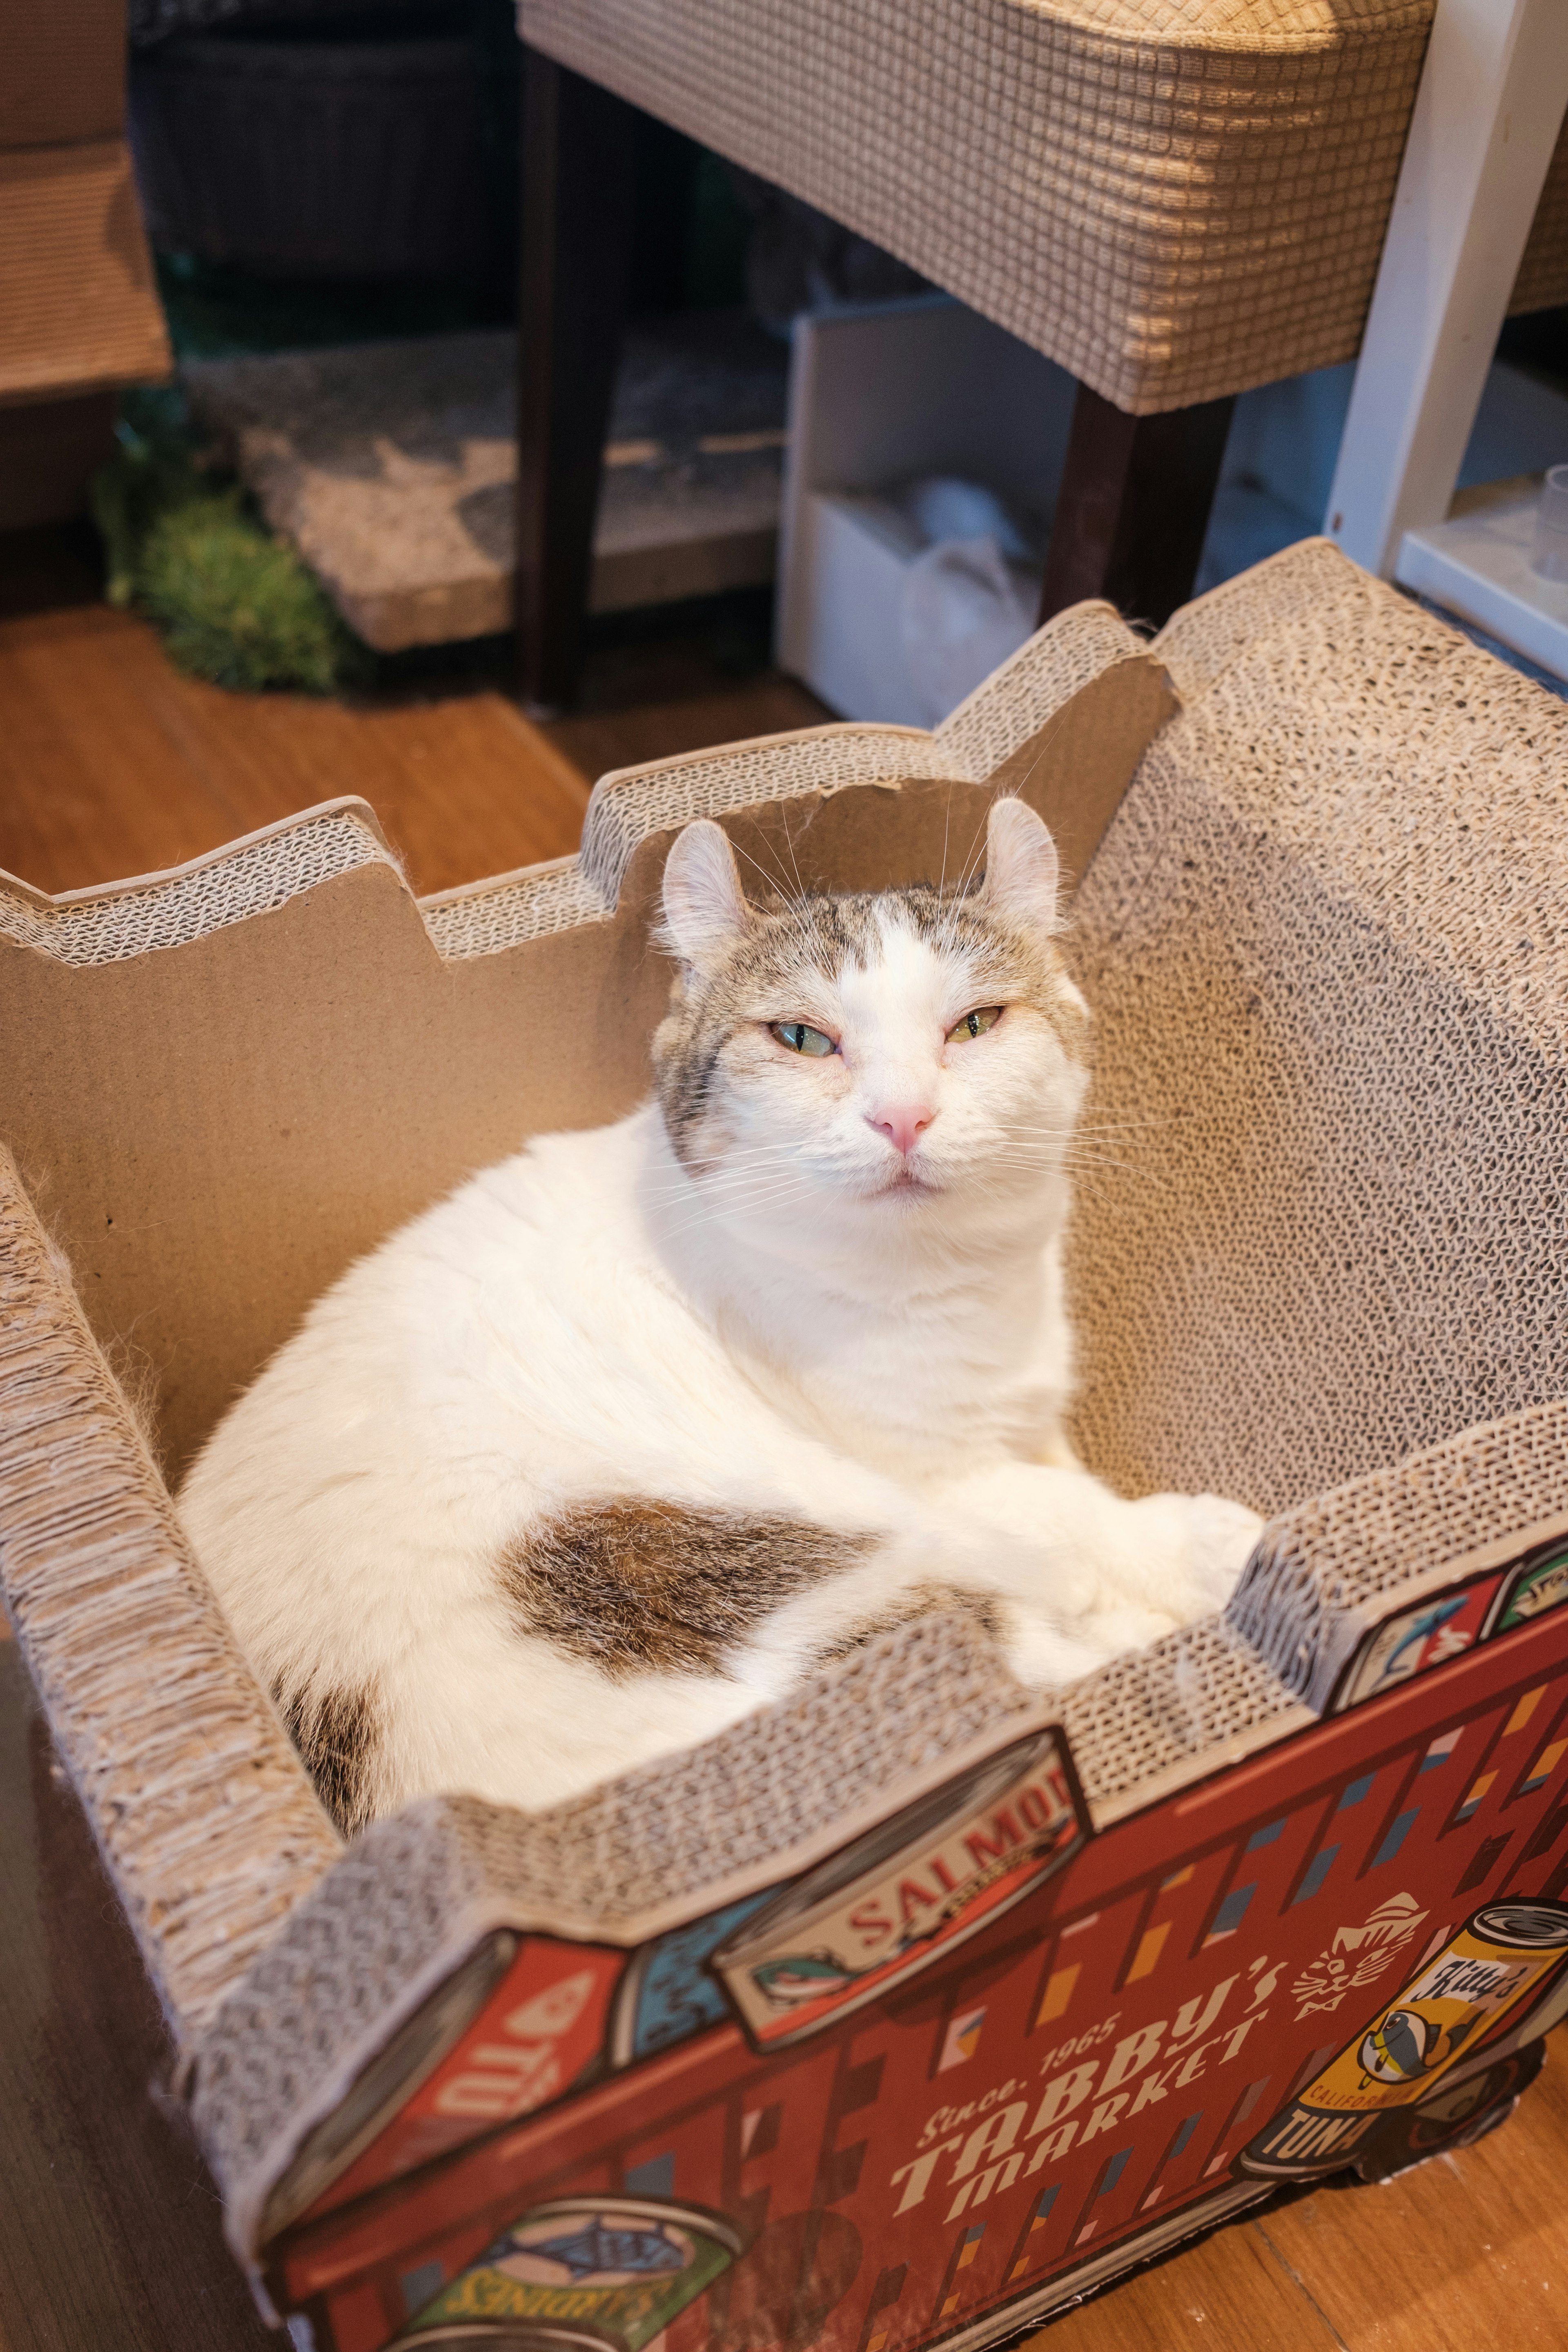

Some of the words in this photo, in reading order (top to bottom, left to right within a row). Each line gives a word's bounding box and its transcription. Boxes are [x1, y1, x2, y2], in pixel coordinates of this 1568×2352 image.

[1410, 1959, 1528, 2003] Kitty's
[1039, 2011, 1123, 2076] 1965
[1262, 2108, 1382, 2159] TUNA
